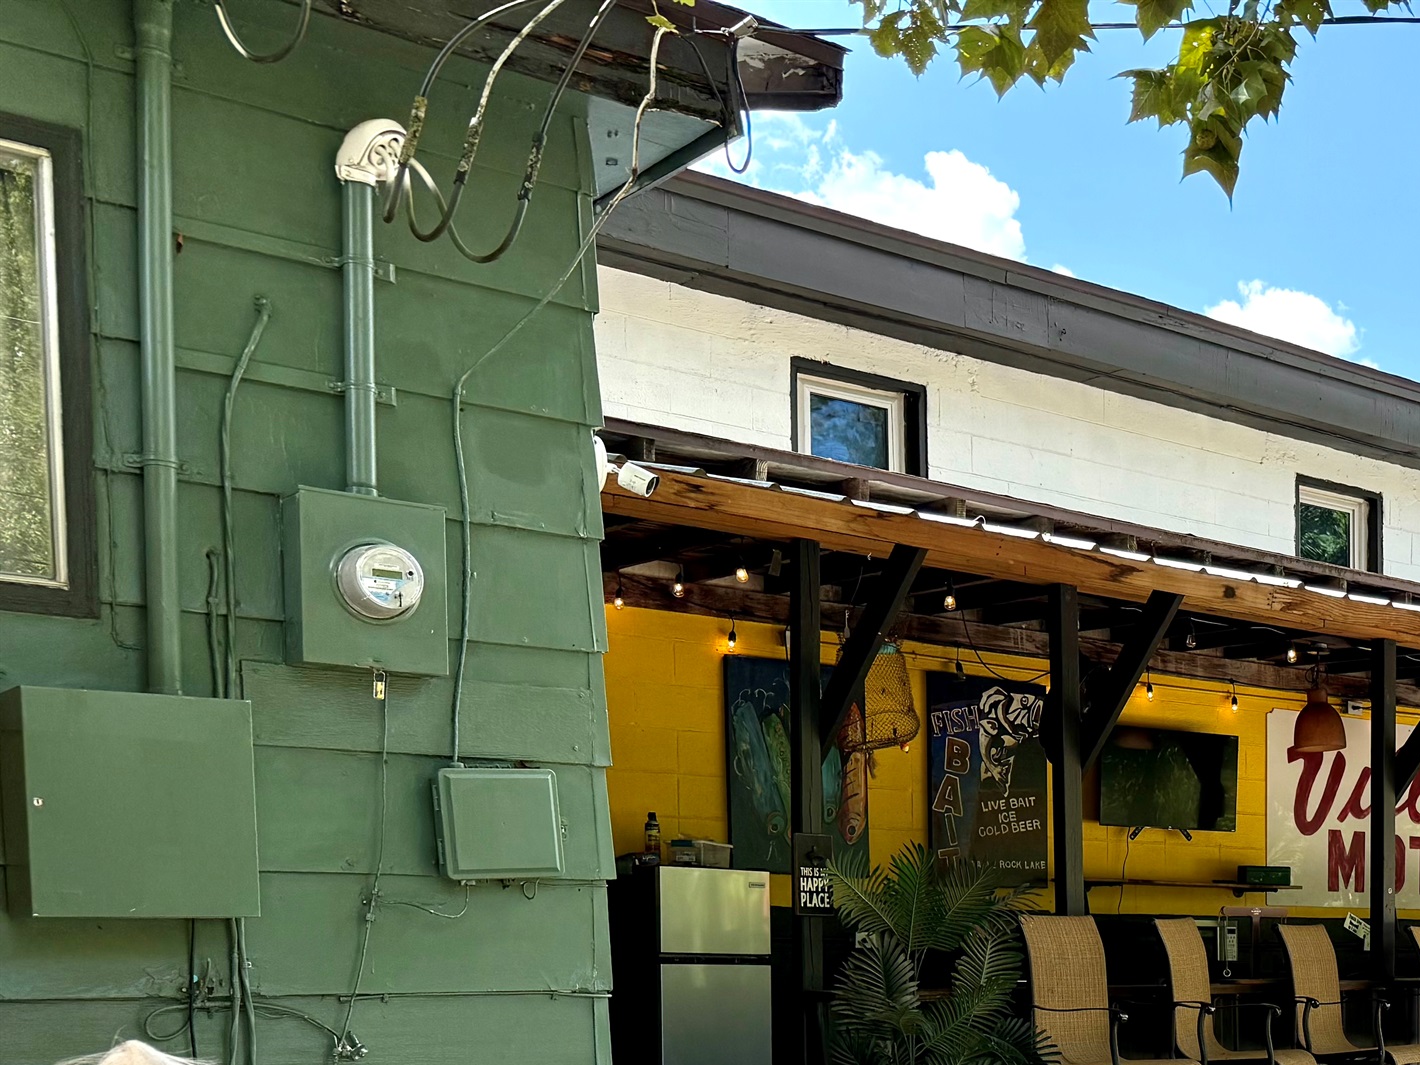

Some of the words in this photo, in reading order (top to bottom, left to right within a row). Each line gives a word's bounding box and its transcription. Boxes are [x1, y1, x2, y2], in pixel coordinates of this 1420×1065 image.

[931, 705, 981, 738] FISH
[932, 736, 972, 870] BAIT
[981, 799, 1007, 813] LIVE
[1009, 796, 1036, 809] BAIT
[998, 811, 1018, 824] ICE
[978, 823, 1010, 838] COLD
[1010, 818, 1042, 834] BEER
[800, 867, 813, 877] THIS
[813, 867, 820, 877] IS
[999, 860, 1023, 870] ROCK
[1024, 860, 1046, 870] LAKE
[800, 877, 830, 893] HAPPY
[800, 892, 831, 908] PLACE
